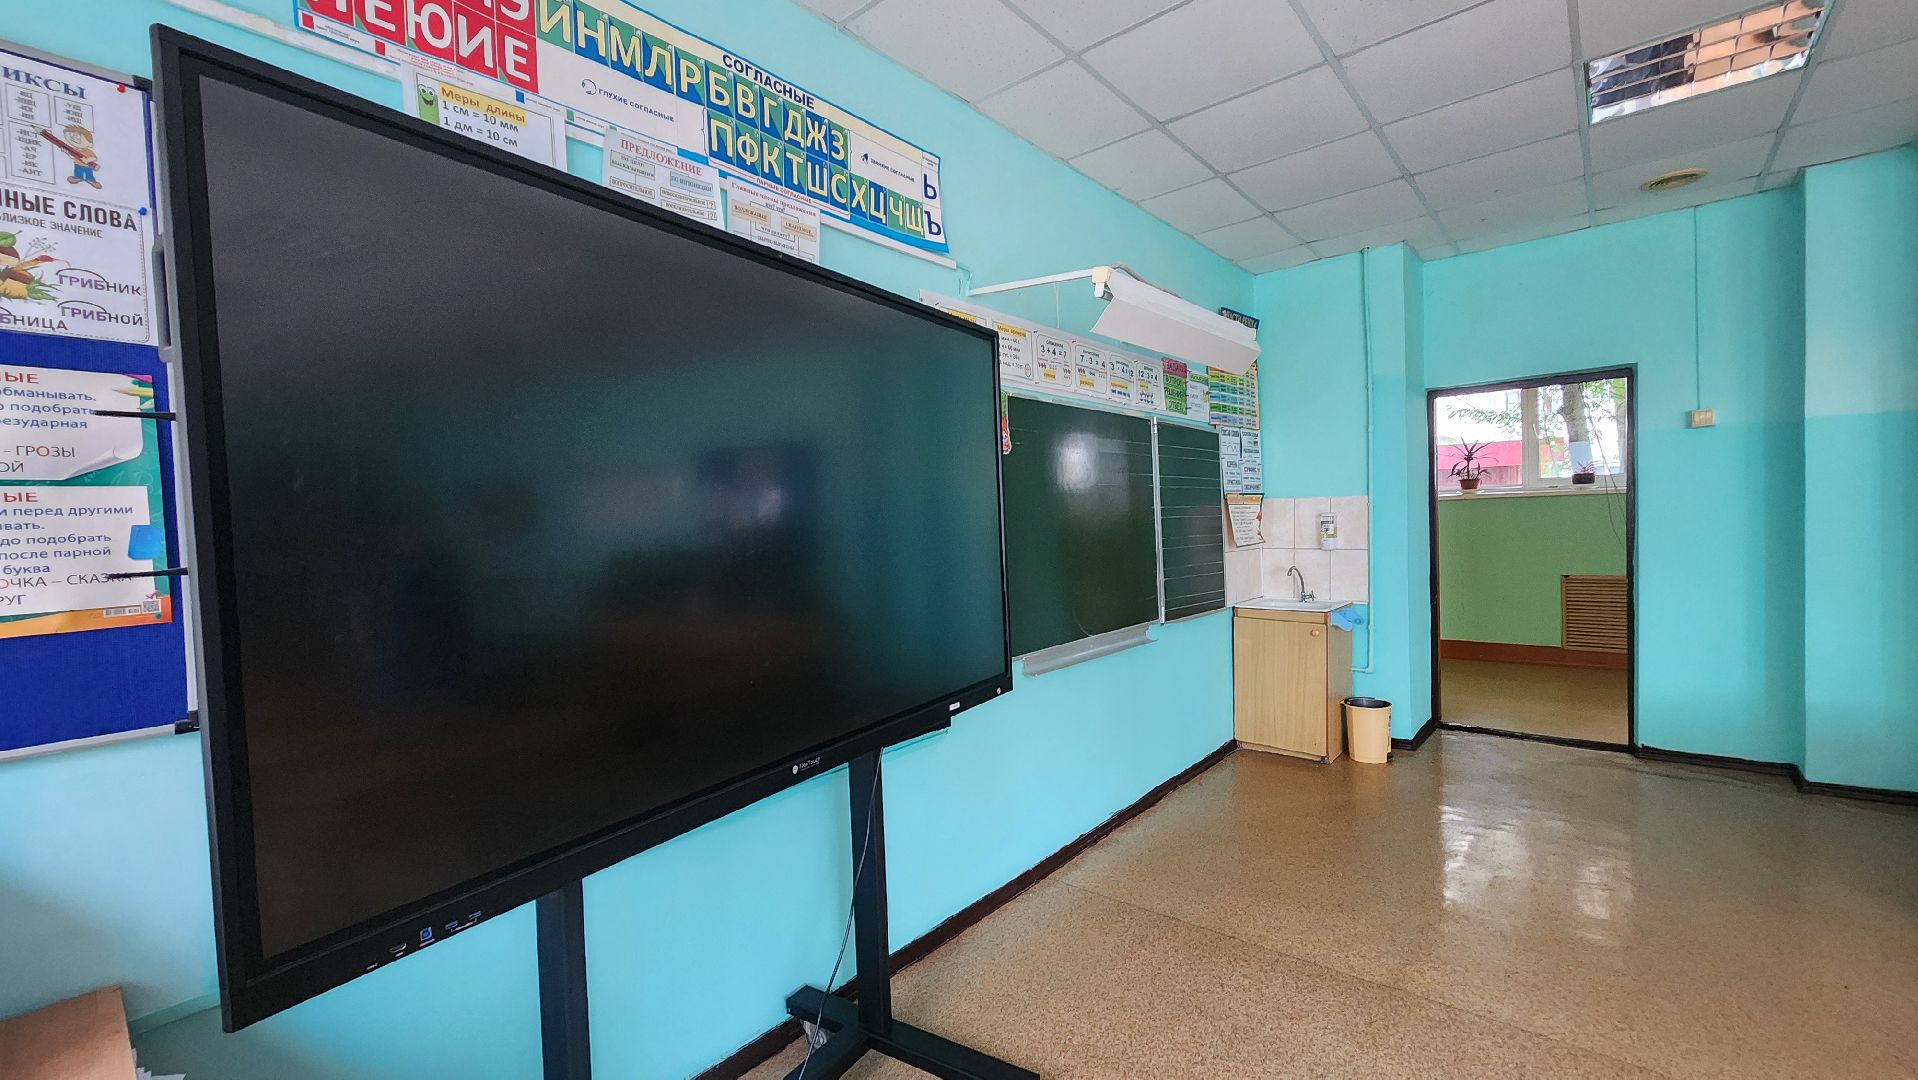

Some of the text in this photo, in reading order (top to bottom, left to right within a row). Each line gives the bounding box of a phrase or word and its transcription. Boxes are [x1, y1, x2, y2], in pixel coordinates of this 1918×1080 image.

[407, 0, 452, 49] Ю
[457, 13, 494, 68] И
[504, 34, 531, 82] Е
[1, 66, 86, 99] ИКСЫ
[575, 10, 606, 57] Н
[609, 25, 642, 73] М
[644, 44, 673, 86] Л
[679, 57, 702, 93] Р
[708, 69, 731, 107] Б
[736, 82, 757, 120] В
[763, 93, 778, 129] Г
[783, 107, 806, 146] Д
[806, 118, 828, 155] Ж
[829, 128, 846, 162] З
[722, 54, 816, 111] СОГЛАСНЫЕ
[440, 87, 480, 108] Меры
[485, 104, 526, 124] длины
[442, 100, 450, 111] 1
[452, 105, 470, 118] см
[483, 113, 497, 126] 10
[499, 120, 519, 134] мм
[598, 87, 675, 122] ГЛУХИЕ СОГЛАСНЫЕ
[443, 116, 451, 127] 1
[454, 120, 474, 134] дм
[486, 129, 500, 142] 10
[502, 136, 519, 148] см
[620, 138, 703, 177] ПРЕДЛОЖЕНИЕ
[709, 118, 734, 158] П
[736, 132, 759, 166] Ф
[762, 141, 783, 178] К
[785, 150, 804, 186] Т
[807, 160, 829, 198] Ш
[831, 170, 848, 205] С
[851, 179, 867, 216] Х
[870, 186, 888, 224] Ц
[889, 195, 904, 228] Ч
[905, 201, 926, 240] Щ
[923, 173, 938, 200] Ь
[0, 189, 138, 232] НЫЕ СЛОВА
[923, 210, 942, 237] Ъ
[0, 212, 104, 239] ЛИЗКОЕ ЗНАЧЕНИЕ
[58, 274, 143, 298] ГРИБНИК
[60, 305, 144, 327] ГРИБНОЙ
[0, 371, 40, 385] ЫЕ
[0, 387, 97, 402] бманывать.
[0, 418, 88, 430] езударная
[16, 445, 76, 458] ГРОЗЫ
[3, 491, 40, 503] ЫЕ
[0, 521, 46, 531] вать.
[13, 507, 65, 518] перед
[67, 505, 134, 520] другими
[26, 533, 112, 546] подобрать
[0, 546, 112, 562] после парной
[3, 564, 51, 577] буква
[66, 572, 133, 586] СКАЗ
